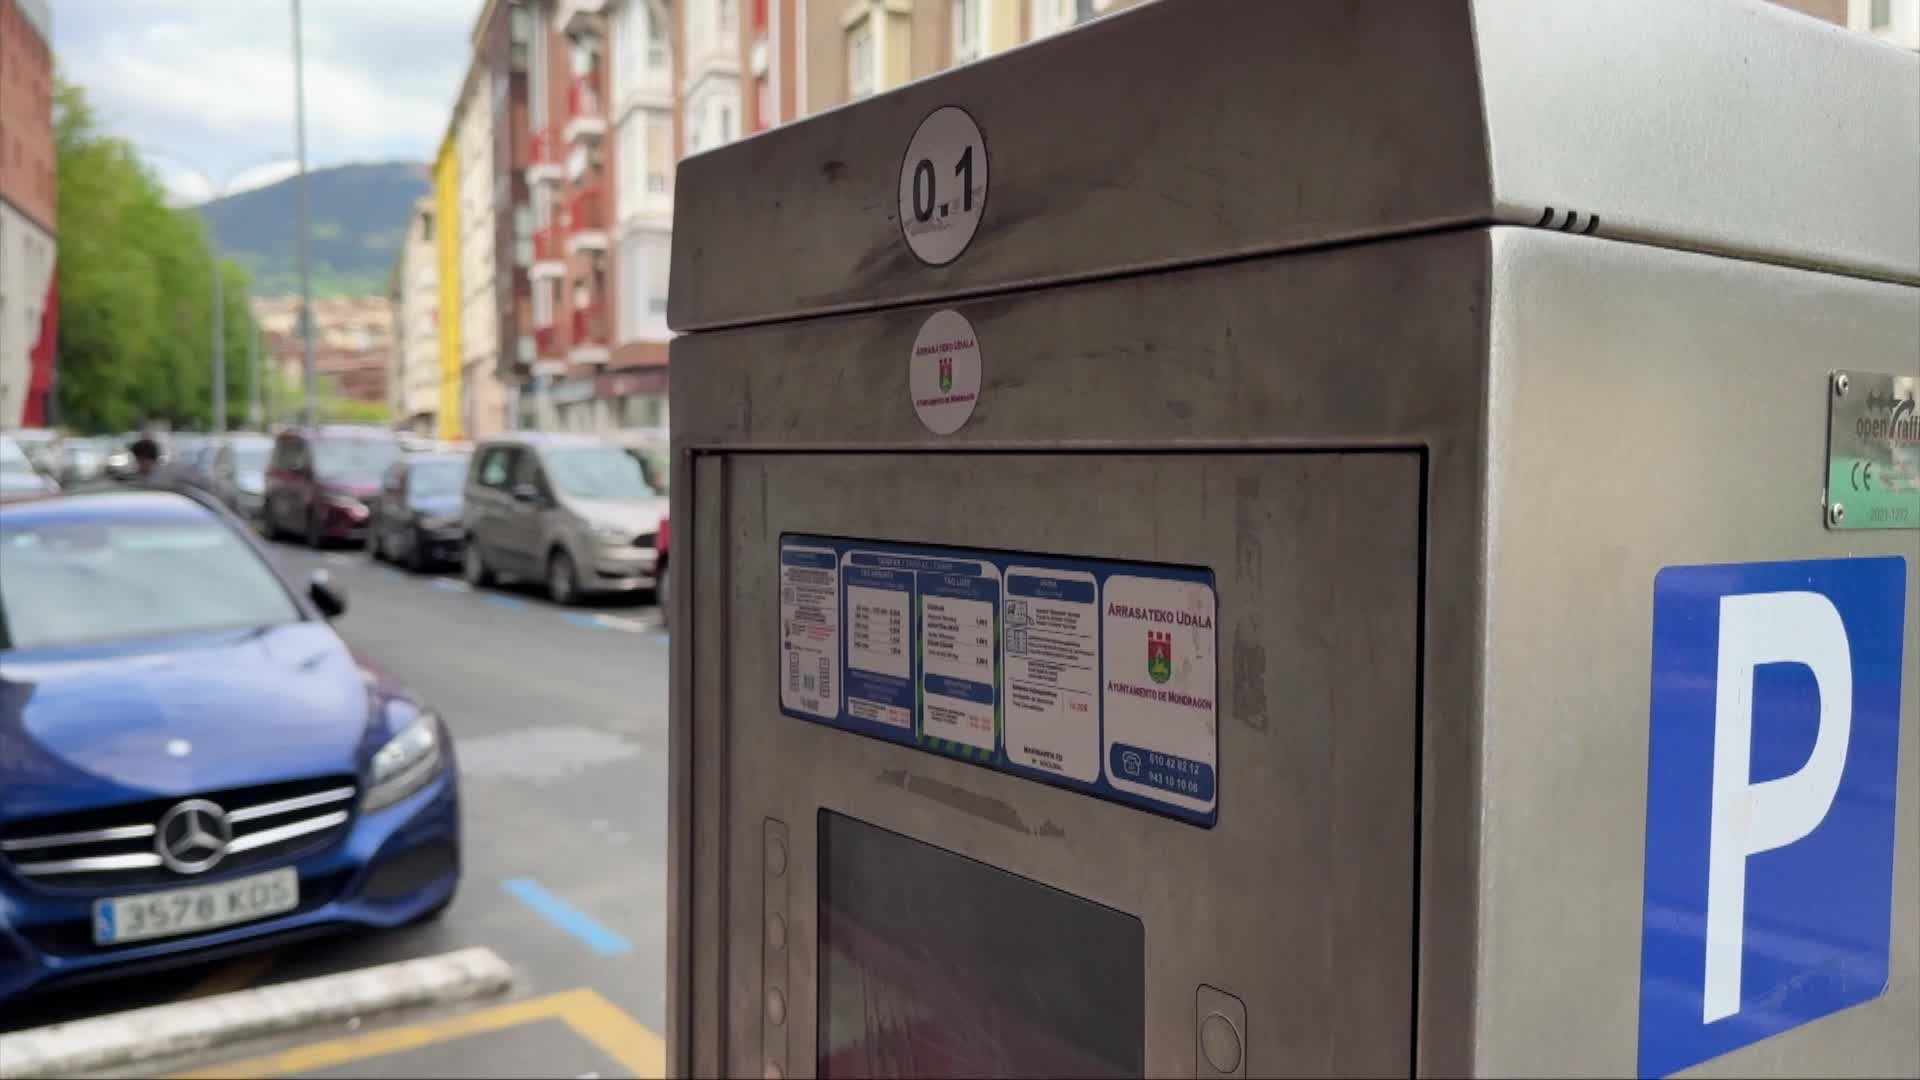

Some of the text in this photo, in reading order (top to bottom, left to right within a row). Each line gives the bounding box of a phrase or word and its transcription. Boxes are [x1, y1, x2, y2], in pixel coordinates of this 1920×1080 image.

[912, 145, 973, 222] 0.1
[1107, 602, 1212, 629] ARRASATEKO UDALA
[1107, 680, 1157, 701] AYUNTAMIENTO
[1158, 691, 1167, 702] DE
[1703, 591, 1853, 1025] P
